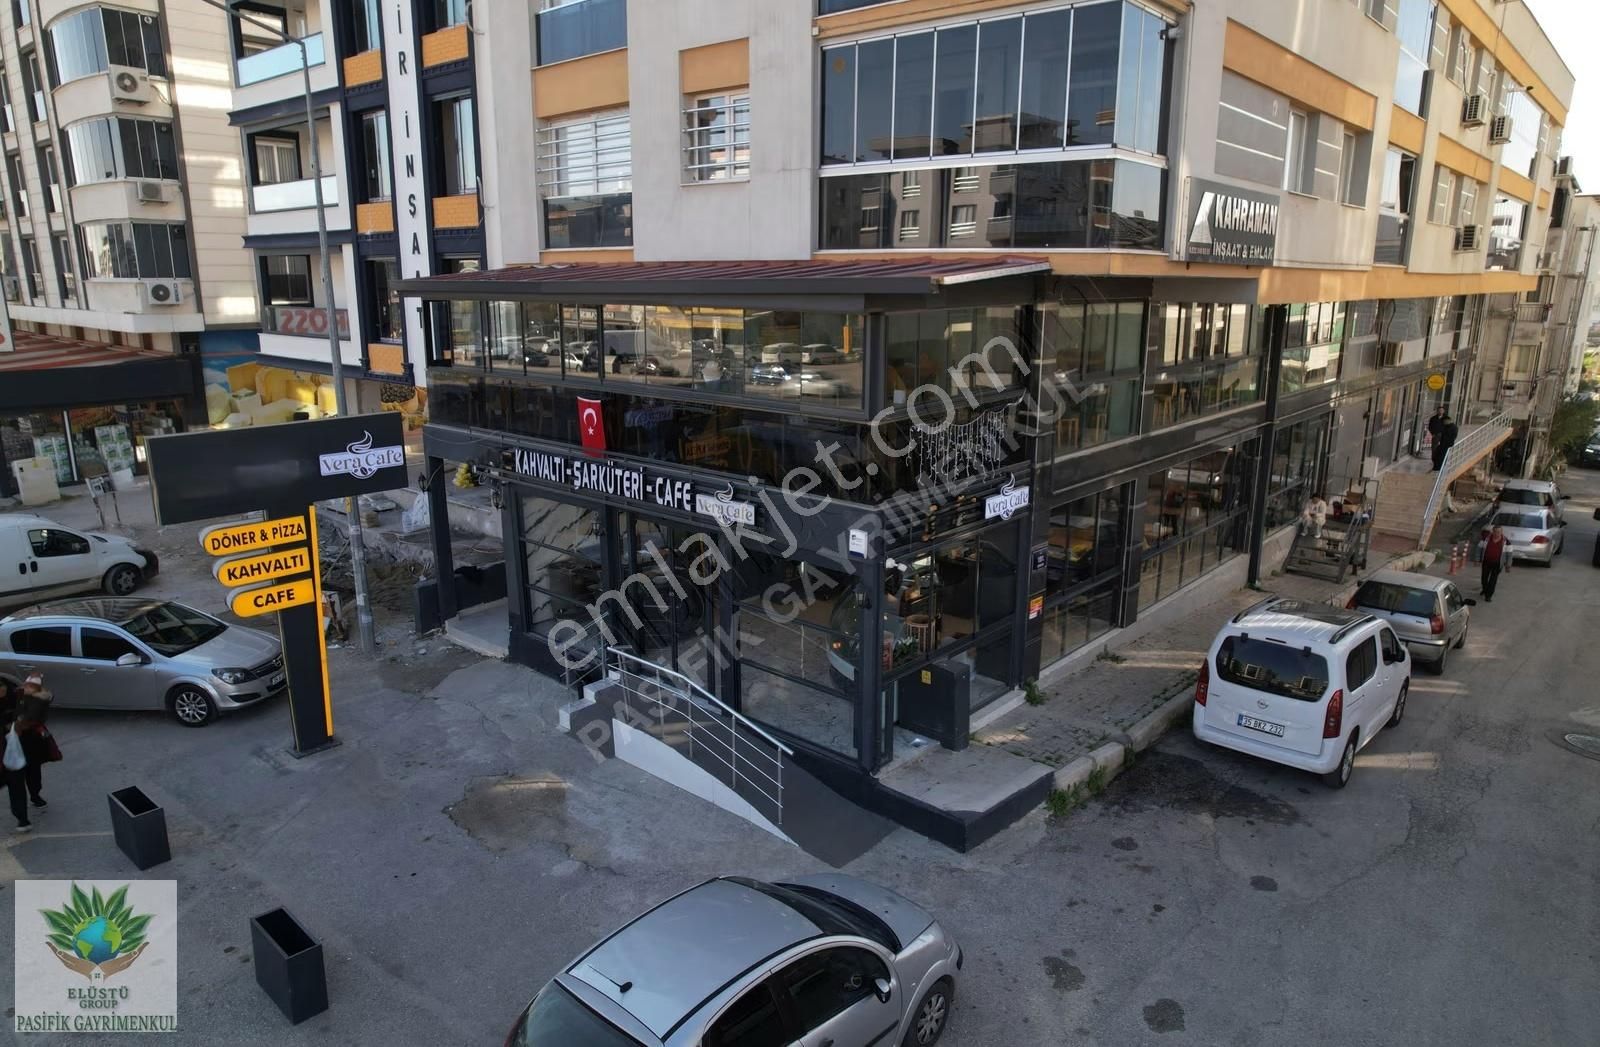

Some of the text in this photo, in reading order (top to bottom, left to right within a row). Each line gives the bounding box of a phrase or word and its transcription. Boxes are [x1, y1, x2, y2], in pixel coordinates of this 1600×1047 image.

[1215, 193, 1278, 235] KAHRAMAN
[1213, 238, 1241, 260] İNŞAAT
[1242, 244, 1248, 259] &
[1249, 245, 1274, 260] EMLAK
[322, 449, 402, 472] Vera Cafe
[698, 498, 753, 522] Vera Cafe
[987, 490, 1028, 515] Vera Cafe
[211, 523, 304, 551] DÖNER & PİZZA
[227, 554, 304, 581] KAHVALTI
[253, 588, 296, 608] CAFE
